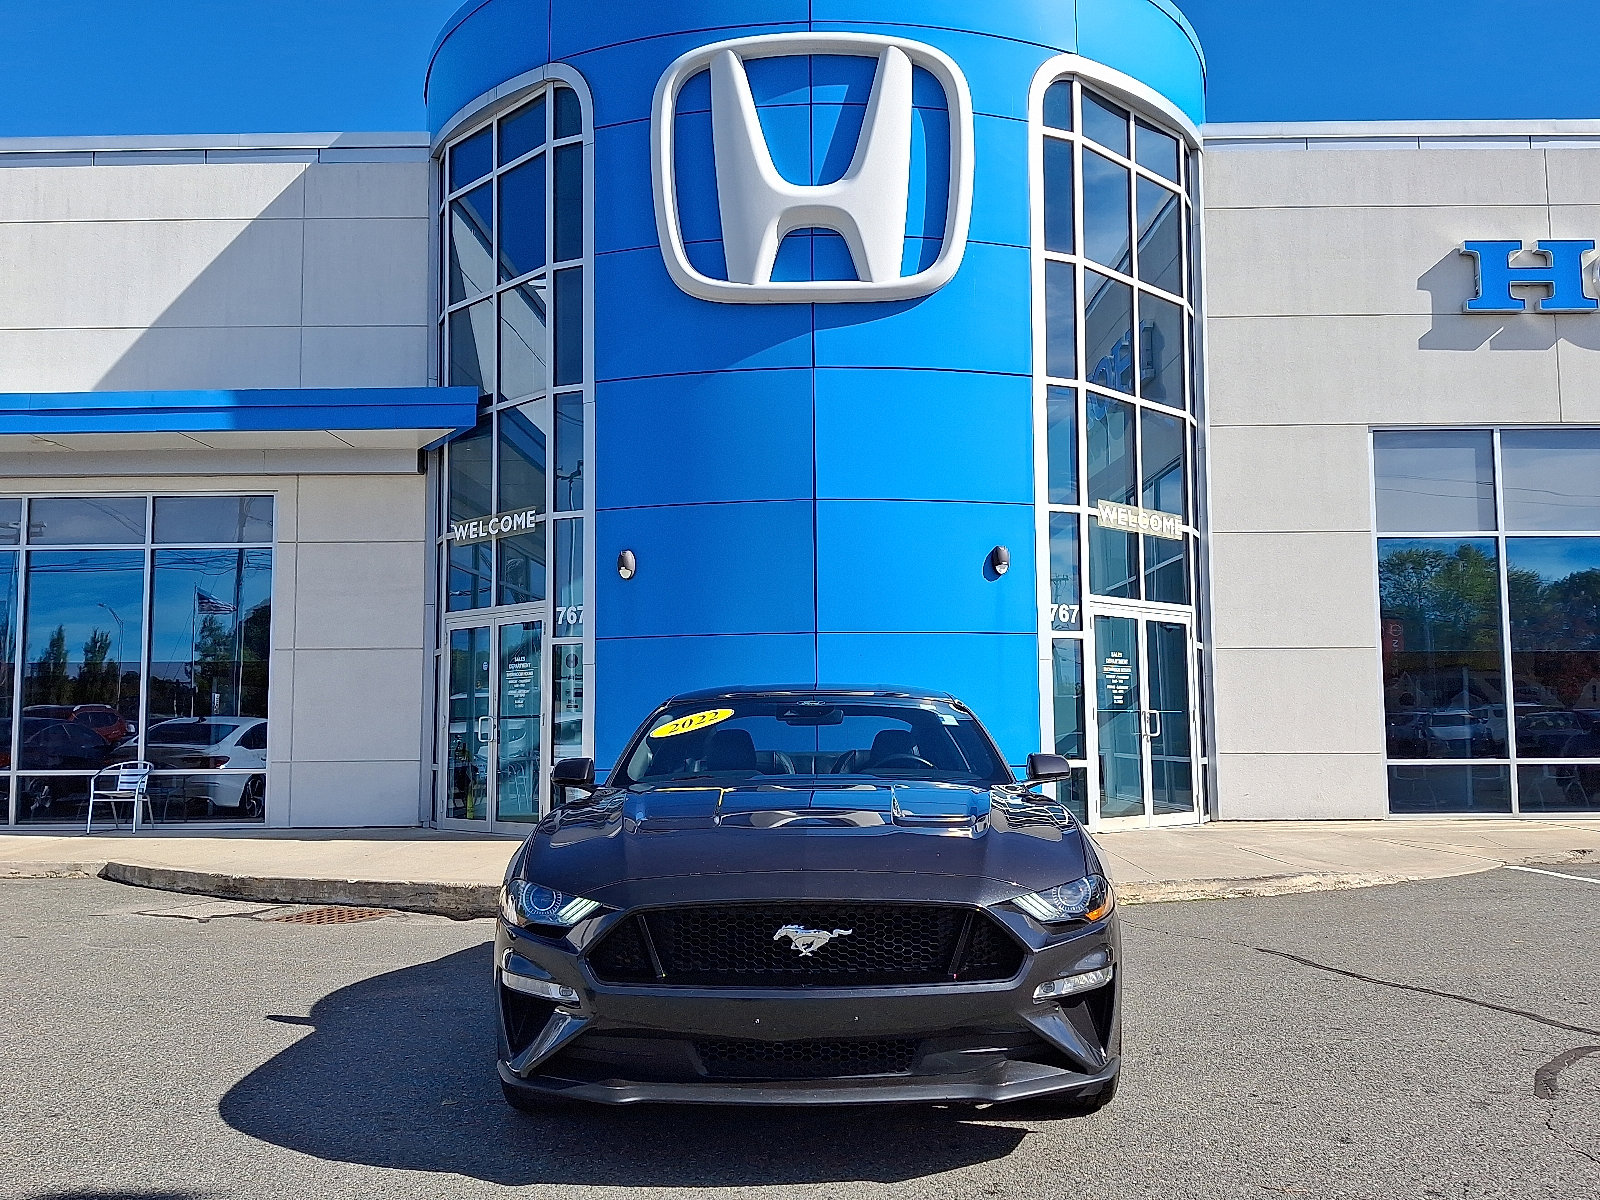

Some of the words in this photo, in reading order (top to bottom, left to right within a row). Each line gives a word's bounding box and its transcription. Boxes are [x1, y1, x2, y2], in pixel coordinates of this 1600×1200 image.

[1458, 239, 1600, 313] H
[453, 509, 536, 541] WELCOME
[1098, 504, 1182, 537] WELCOME
[556, 605, 583, 624] 767
[1051, 604, 1079, 624] 767
[668, 711, 719, 735] 2022
